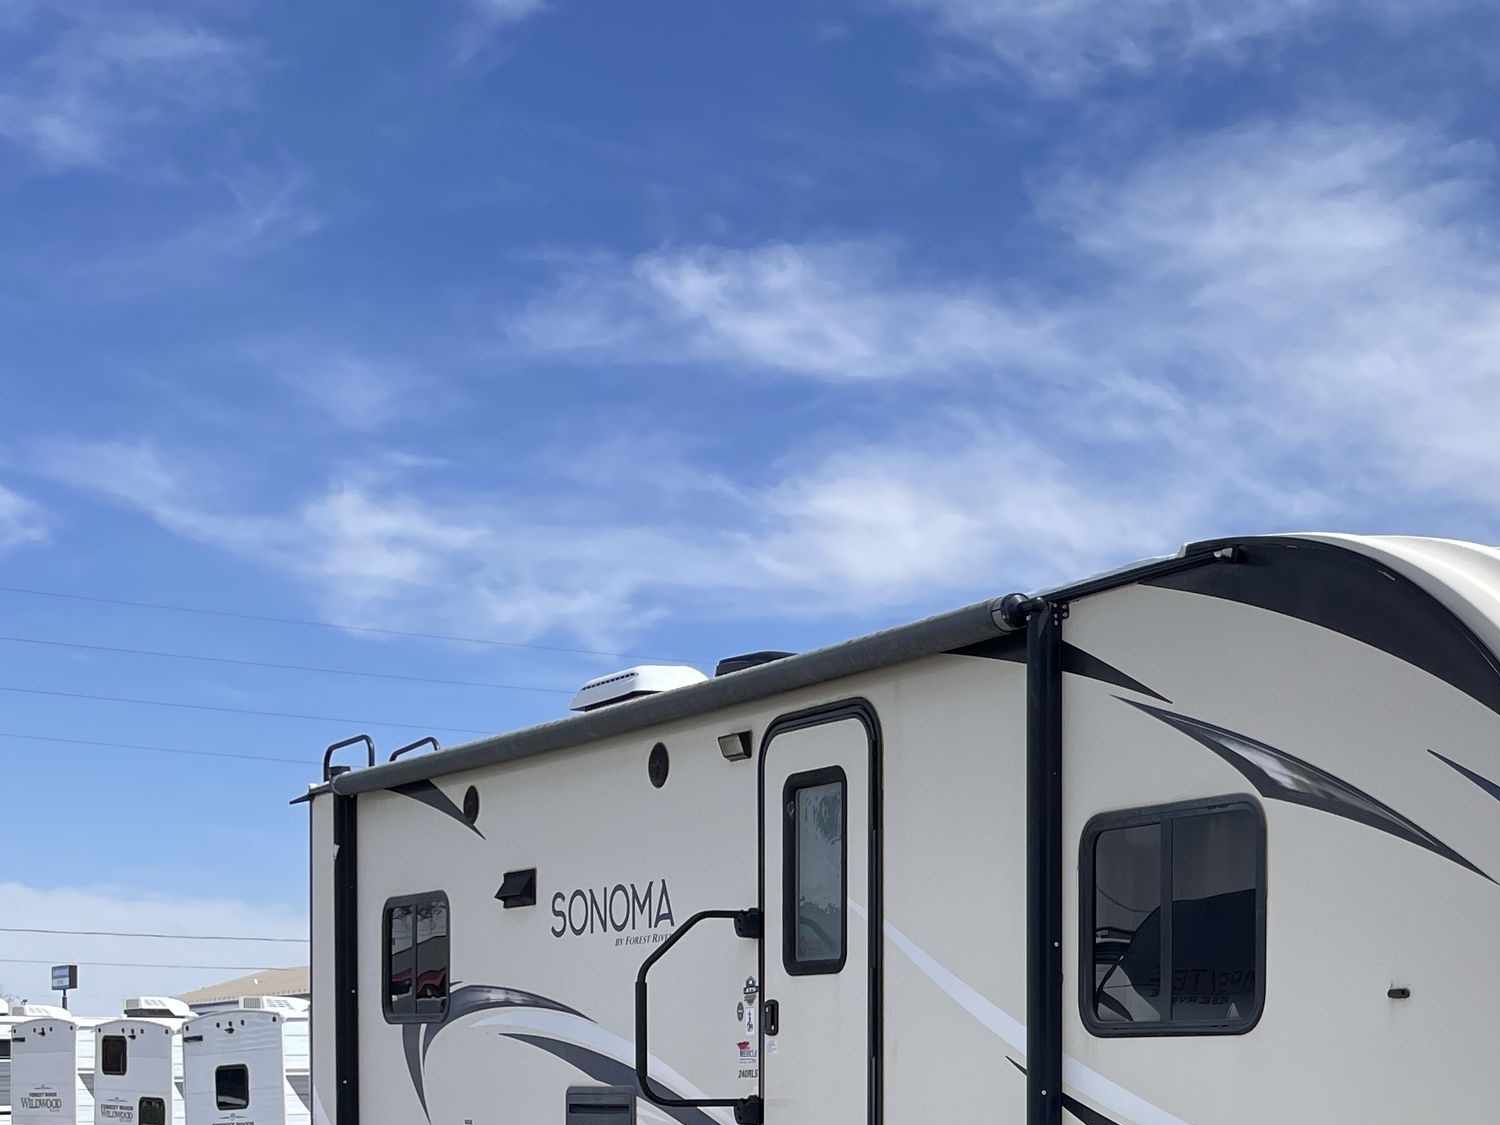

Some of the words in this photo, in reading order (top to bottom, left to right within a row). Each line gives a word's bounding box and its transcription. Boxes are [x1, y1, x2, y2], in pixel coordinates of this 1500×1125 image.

[550, 879, 675, 938] SONOMA
[615, 938, 623, 946] BY
[625, 936, 652, 946] FOREST
[20, 1097, 62, 1109] WILDWOOD
